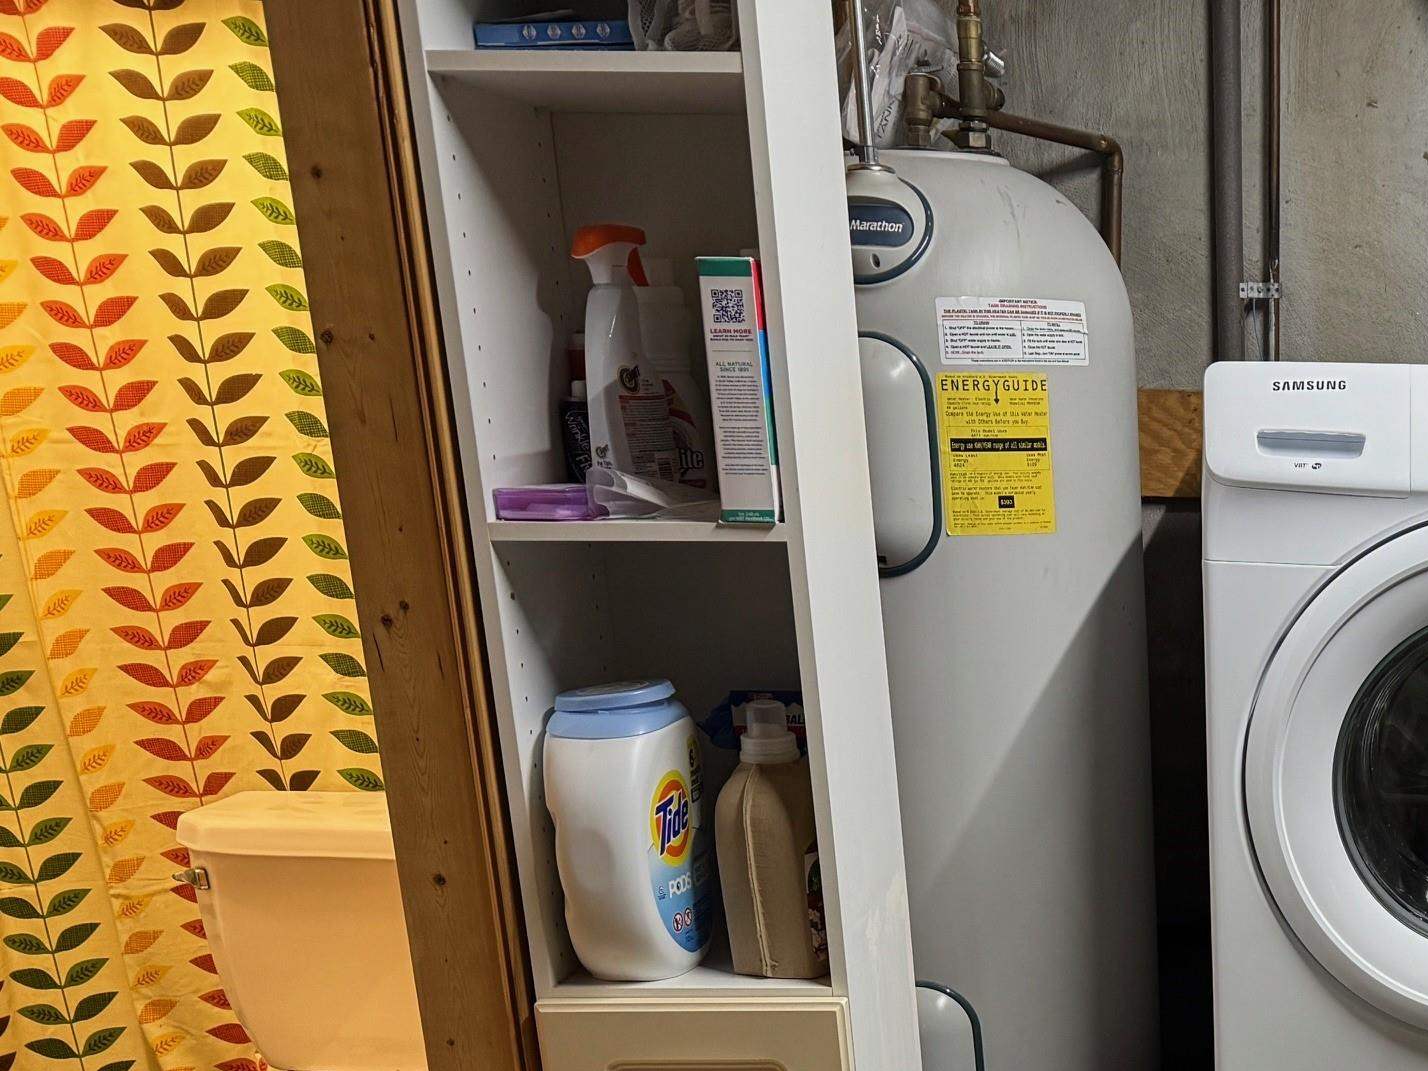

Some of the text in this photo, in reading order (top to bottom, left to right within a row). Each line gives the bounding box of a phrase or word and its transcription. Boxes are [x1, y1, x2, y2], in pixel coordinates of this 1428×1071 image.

[850, 219, 903, 233] Marathon
[941, 379, 1047, 394] ENERGYGUIDE
[1272, 381, 1346, 391] SAMSUNG
[655, 789, 689, 856] Tide
[669, 871, 692, 898] PODS
